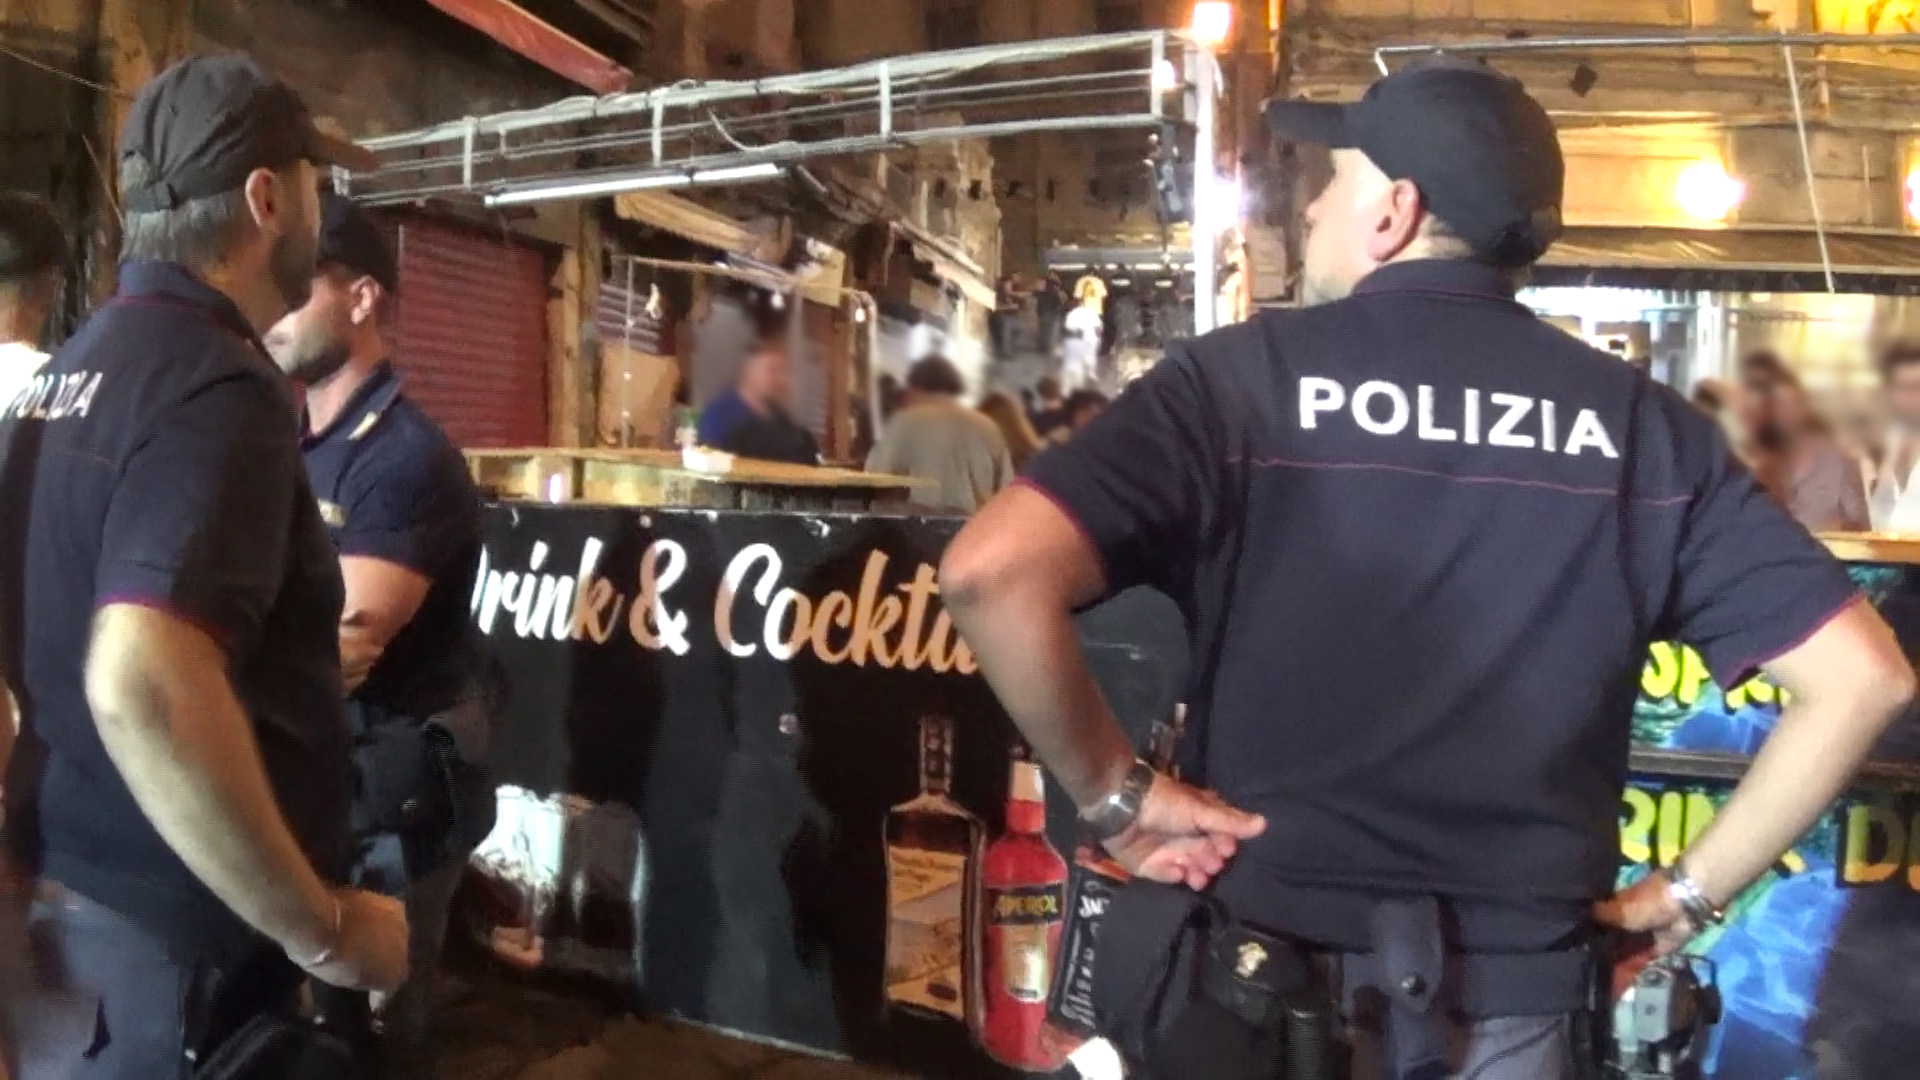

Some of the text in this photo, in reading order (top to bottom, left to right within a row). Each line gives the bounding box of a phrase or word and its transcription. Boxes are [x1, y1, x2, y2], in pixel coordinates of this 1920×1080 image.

[1299, 376, 1619, 458] POLIZIA
[470, 536, 624, 649] rink
[629, 539, 692, 655] &
